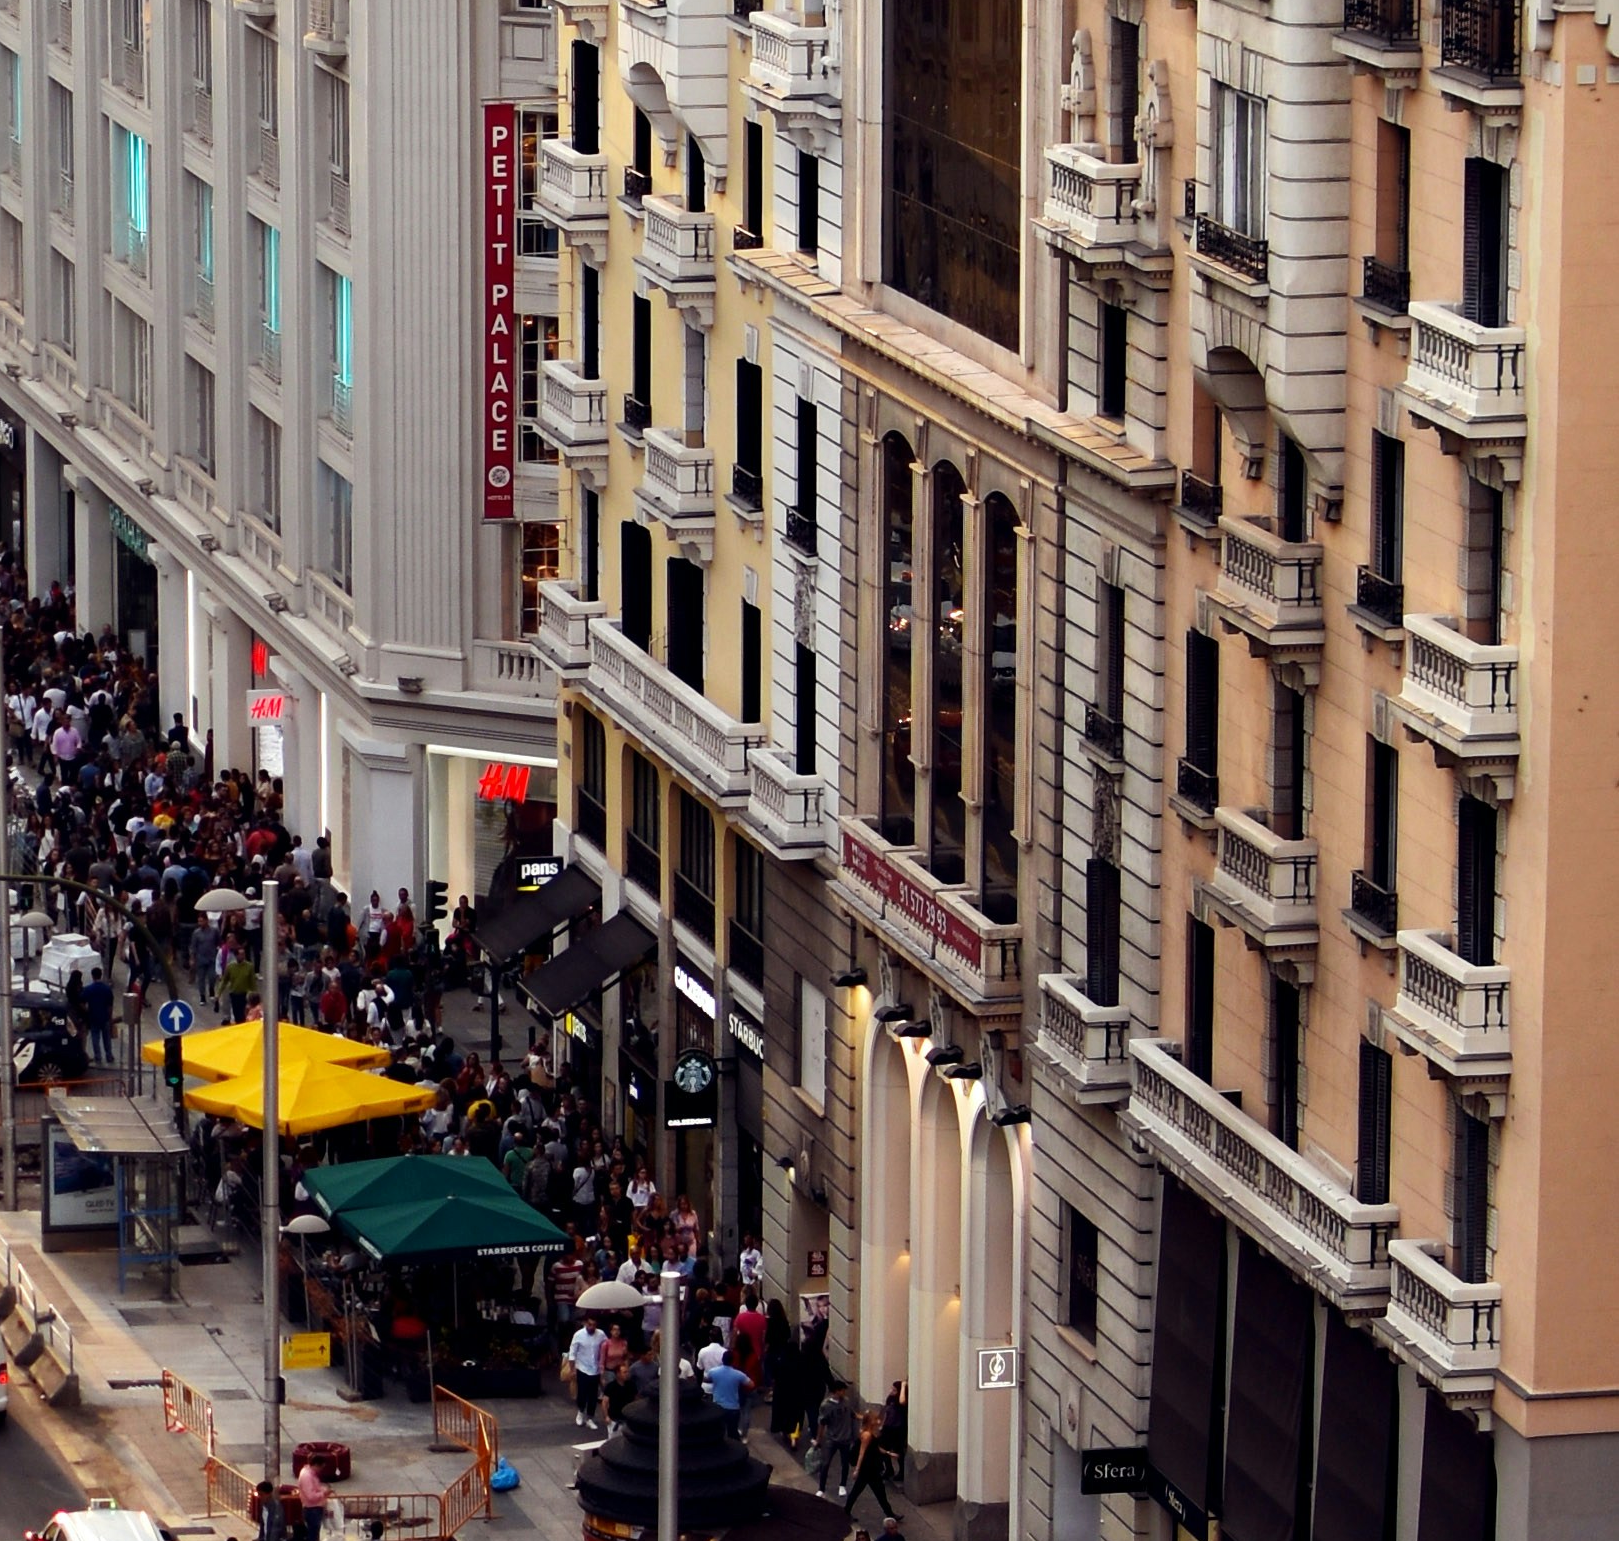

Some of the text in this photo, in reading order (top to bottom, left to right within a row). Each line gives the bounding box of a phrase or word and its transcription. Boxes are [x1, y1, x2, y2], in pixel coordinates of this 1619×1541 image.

[491, 126, 509, 266] PETIT
[491, 284, 509, 451] PALACE
[521, 862, 559, 879] pans
[937, 908, 947, 935] 93
[728, 1013, 764, 1060] STARBUC
[476, 1245, 530, 1256] STARBUCKS
[1093, 1462, 1136, 1479] Sfera
